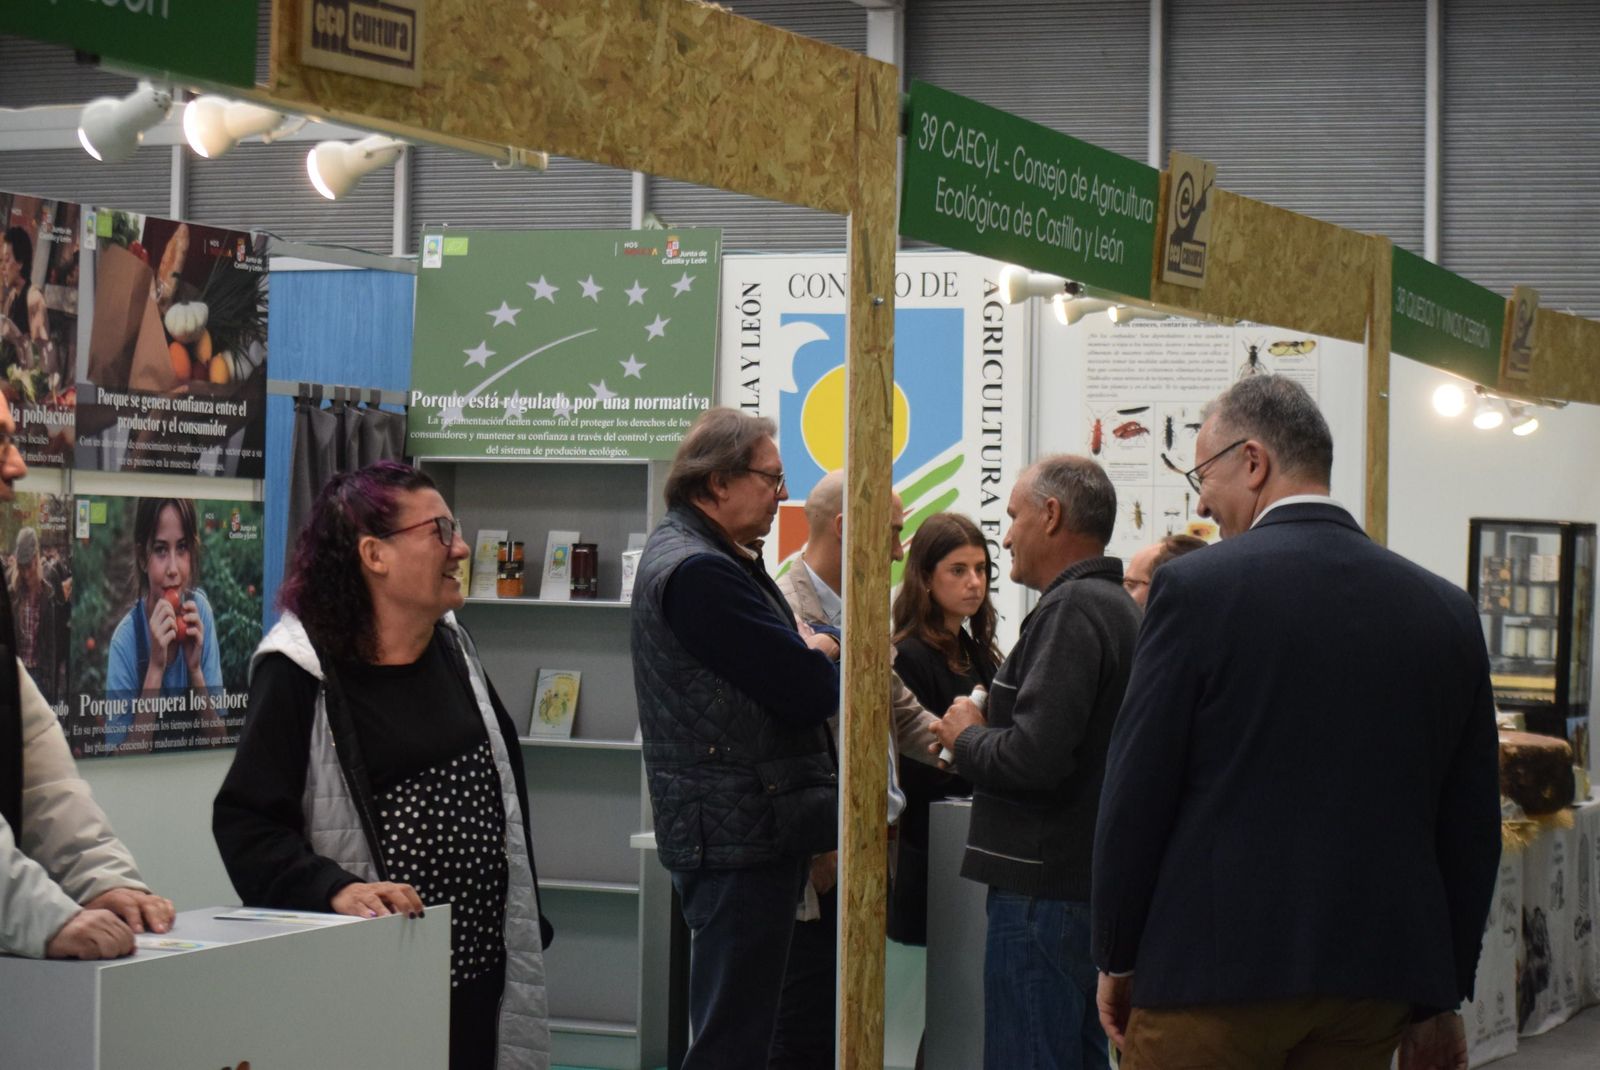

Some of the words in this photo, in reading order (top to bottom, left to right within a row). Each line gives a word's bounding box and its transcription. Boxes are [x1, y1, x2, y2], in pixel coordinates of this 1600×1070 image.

[316, 2, 346, 38] eco
[353, 11, 408, 52] cultura
[918, 112, 938, 152] 39
[942, 120, 1000, 179] CAECyL
[1013, 146, 1067, 200] Consejo
[1070, 163, 1088, 202] de
[1090, 174, 1154, 224] Agricultura
[935, 176, 1010, 234] Ecológica
[1013, 200, 1032, 238] de
[1035, 207, 1082, 254] Castilla
[1084, 232, 1092, 264] y
[1094, 226, 1124, 265] León
[788, 272, 912, 299] CONO
[920, 272, 958, 298] DE
[735, 282, 762, 349] LEÓN
[98, 388, 128, 412] Porque
[130, 394, 140, 407] se
[141, 394, 170, 413] genera
[172, 395, 214, 414] confianza
[216, 400, 237, 416] entre
[238, 400, 247, 416] el
[410, 390, 466, 412] Porque
[468, 392, 499, 408] está
[504, 392, 570, 413] regulado
[573, 397, 597, 414] por
[602, 396, 630, 410] una
[634, 392, 710, 410] normativa
[980, 278, 1004, 508] AGRICULTURA
[10, 402, 20, 422] la
[22, 404, 75, 428] población
[118, 414, 160, 434] productor
[162, 422, 168, 436] y
[169, 417, 177, 432] el
[178, 420, 227, 437] consumidor
[427, 416, 438, 425] La
[440, 416, 504, 428] reglamentación
[506, 417, 530, 426] tienen
[532, 418, 556, 426] como
[558, 417, 569, 426] fin
[570, 418, 578, 427] el
[580, 418, 614, 429] proteger
[616, 418, 629, 428] los
[630, 418, 666, 428] derechos
[667, 418, 678, 428] de
[679, 418, 692, 428] los
[410, 430, 468, 440] consumidores
[468, 432, 474, 442] y
[476, 432, 516, 440] mantener
[516, 433, 526, 441] su
[528, 432, 568, 442] confianza
[577, 432, 602, 442] través
[604, 432, 616, 442] del
[617, 432, 648, 442] control
[648, 434, 654, 444] y
[656, 433, 684, 443] certific
[486, 445, 498, 454] del
[500, 446, 531, 455] sistema
[532, 446, 543, 455] de
[544, 446, 587, 457] produción
[588, 447, 630, 458] ecológico.
[80, 694, 128, 720] Porque
[132, 694, 186, 718] recupera
[190, 690, 208, 712] los
[210, 690, 248, 710] sabore
[73, 725, 82, 735] En
[92, 722, 128, 736] producción
[160, 720, 170, 730] los
[170, 719, 192, 732] tiempos
[193, 718, 200, 728] de
[200, 718, 210, 728] los
[120, 740, 149, 752] creciendo
[154, 738, 188, 748] madurando
[188, 737, 194, 747] al
[210, 736, 221, 746] que
